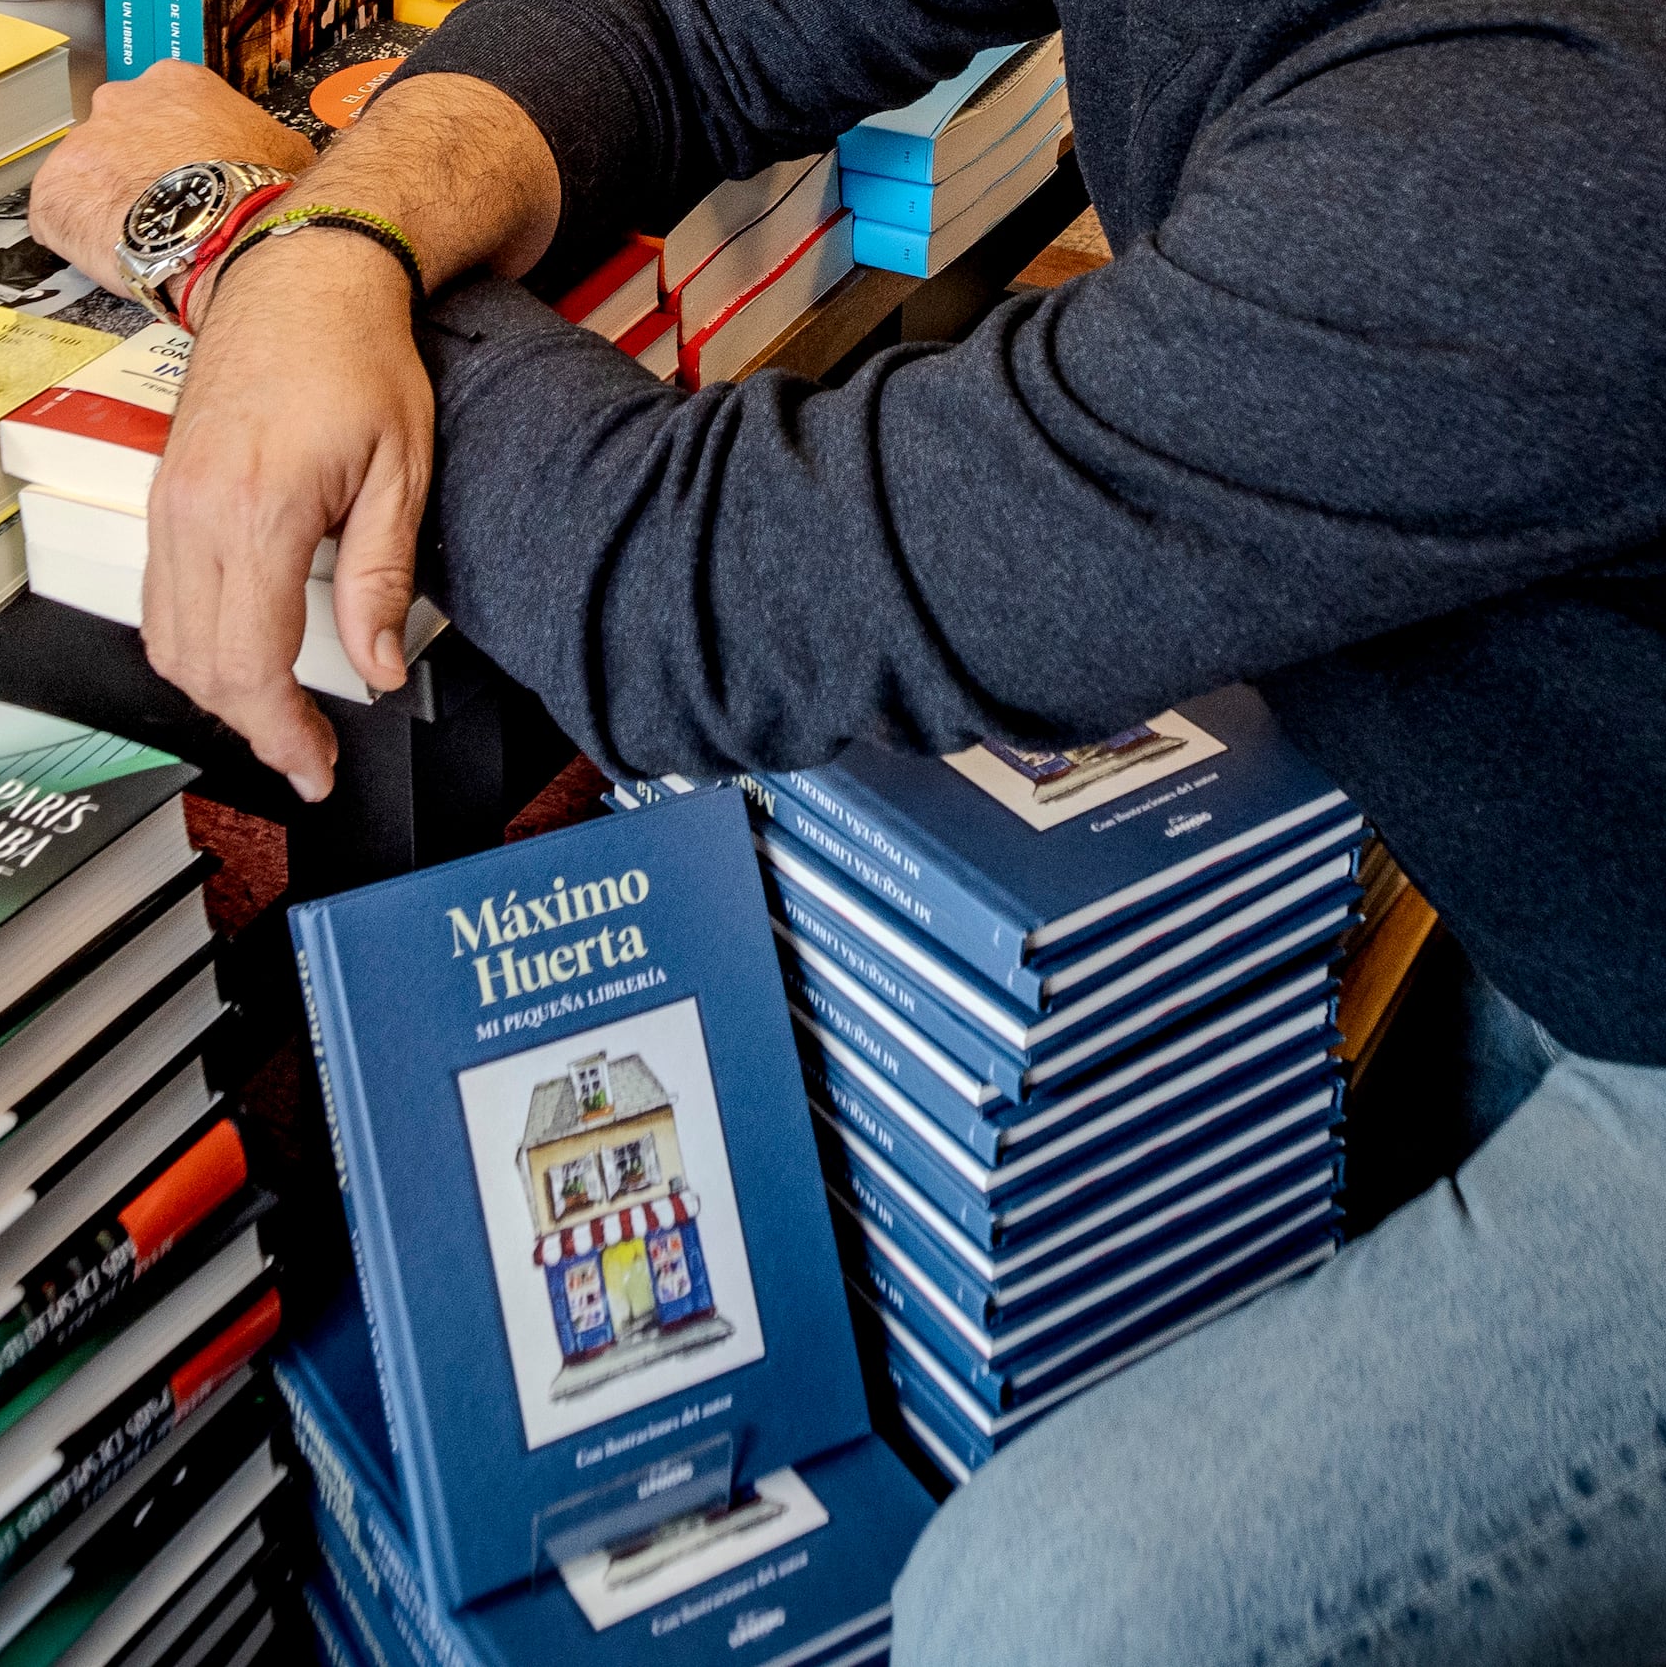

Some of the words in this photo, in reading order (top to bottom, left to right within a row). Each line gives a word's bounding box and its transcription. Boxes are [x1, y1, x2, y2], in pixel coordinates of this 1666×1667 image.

[122, 2, 132, 22] UN
[169, 4, 180, 19] DE
[170, 21, 180, 39] UN
[122, 23, 133, 66] LIBRERO
[796, 814, 852, 866] LIBRERÍA
[845, 813, 902, 865] PEQUEÑA
[854, 859, 912, 911] PEQUEÑA
[902, 859, 921, 880] MI
[445, 869, 650, 959] Máximo
[913, 904, 932, 925] MI
[472, 924, 649, 1007] Huerta
